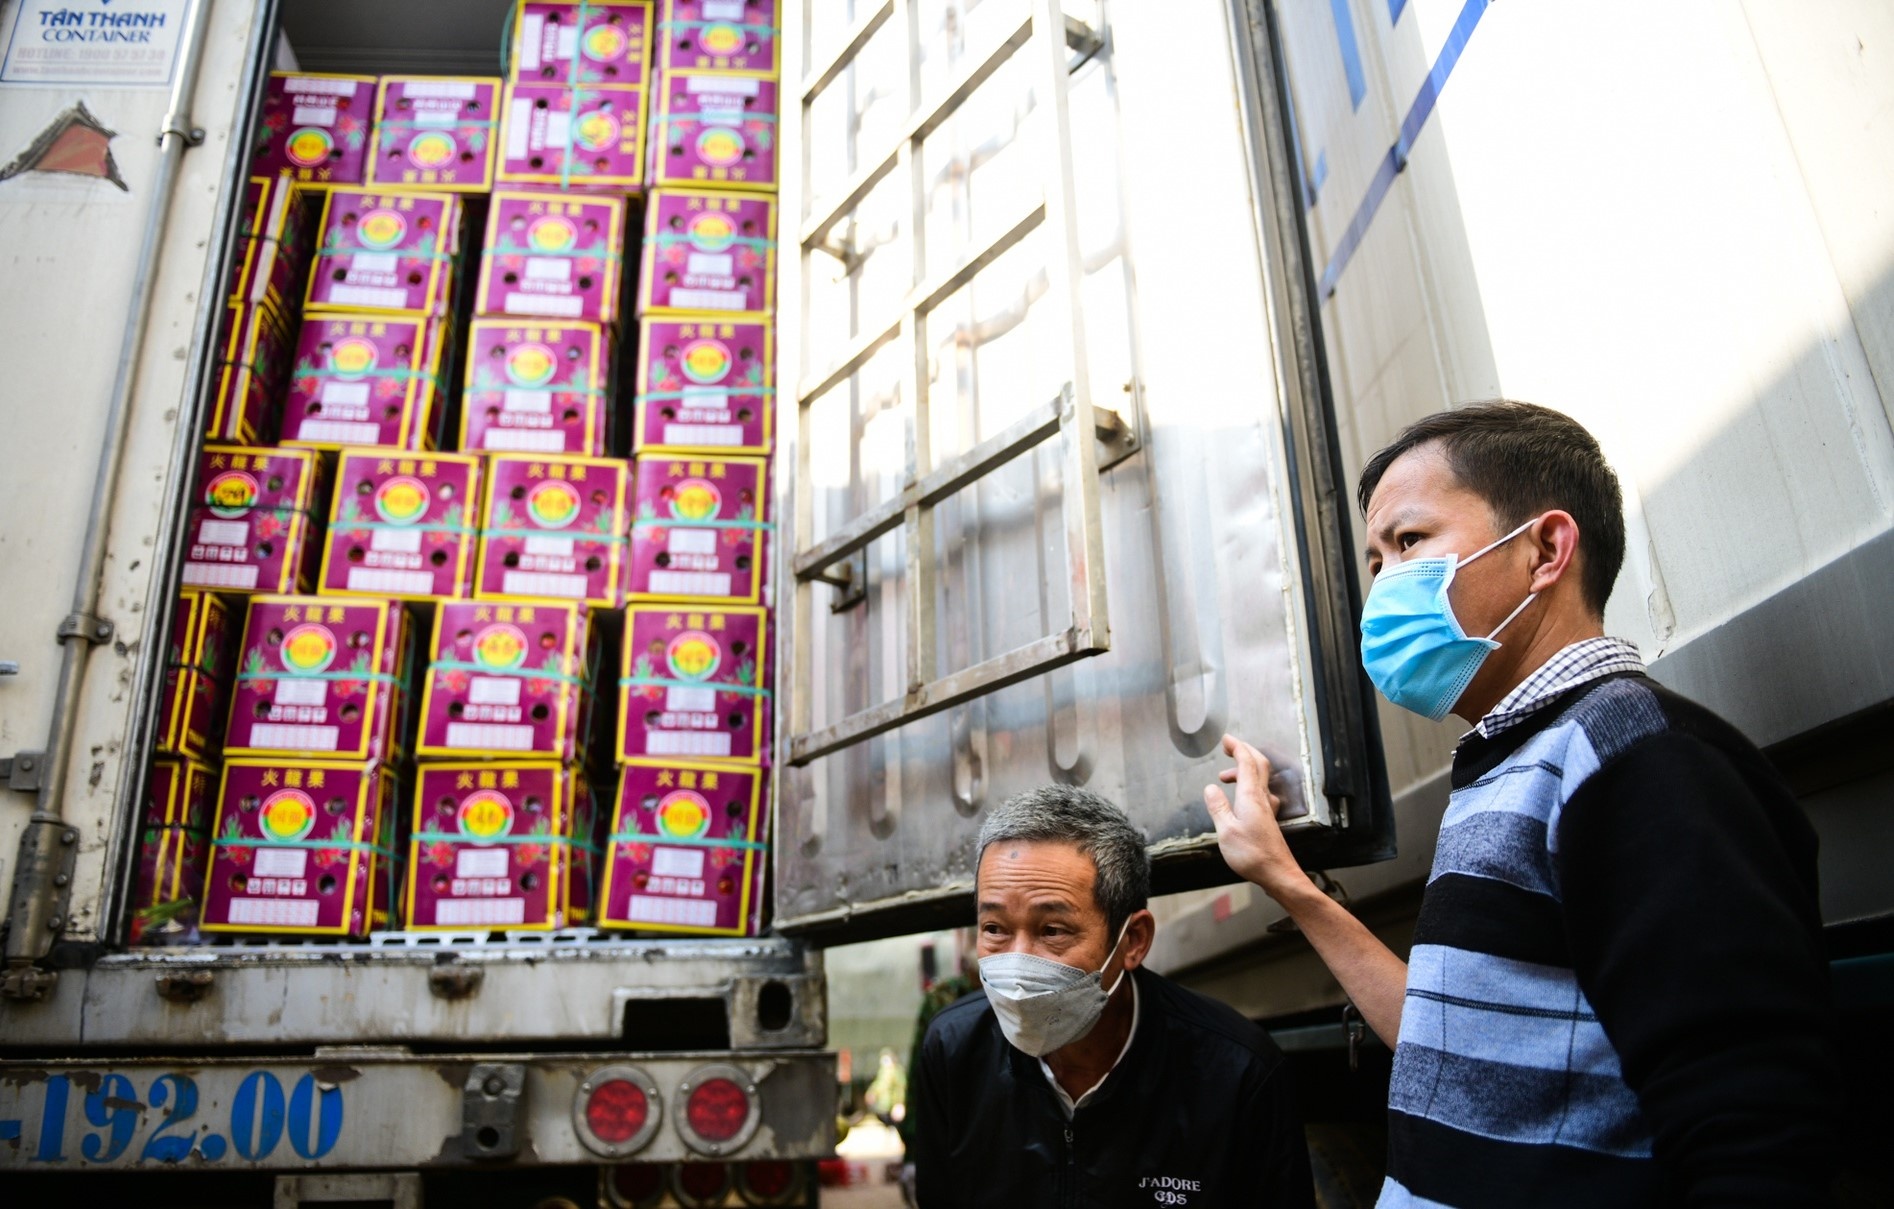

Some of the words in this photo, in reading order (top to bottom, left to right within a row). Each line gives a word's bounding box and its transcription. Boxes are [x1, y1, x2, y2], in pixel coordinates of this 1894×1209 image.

[88, 12, 166, 27] THANH
[42, 28, 152, 43] CONTAINER
[261, 769, 325, 788] 火龍果
[1139, 1176, 1201, 1191] J'ADORE
